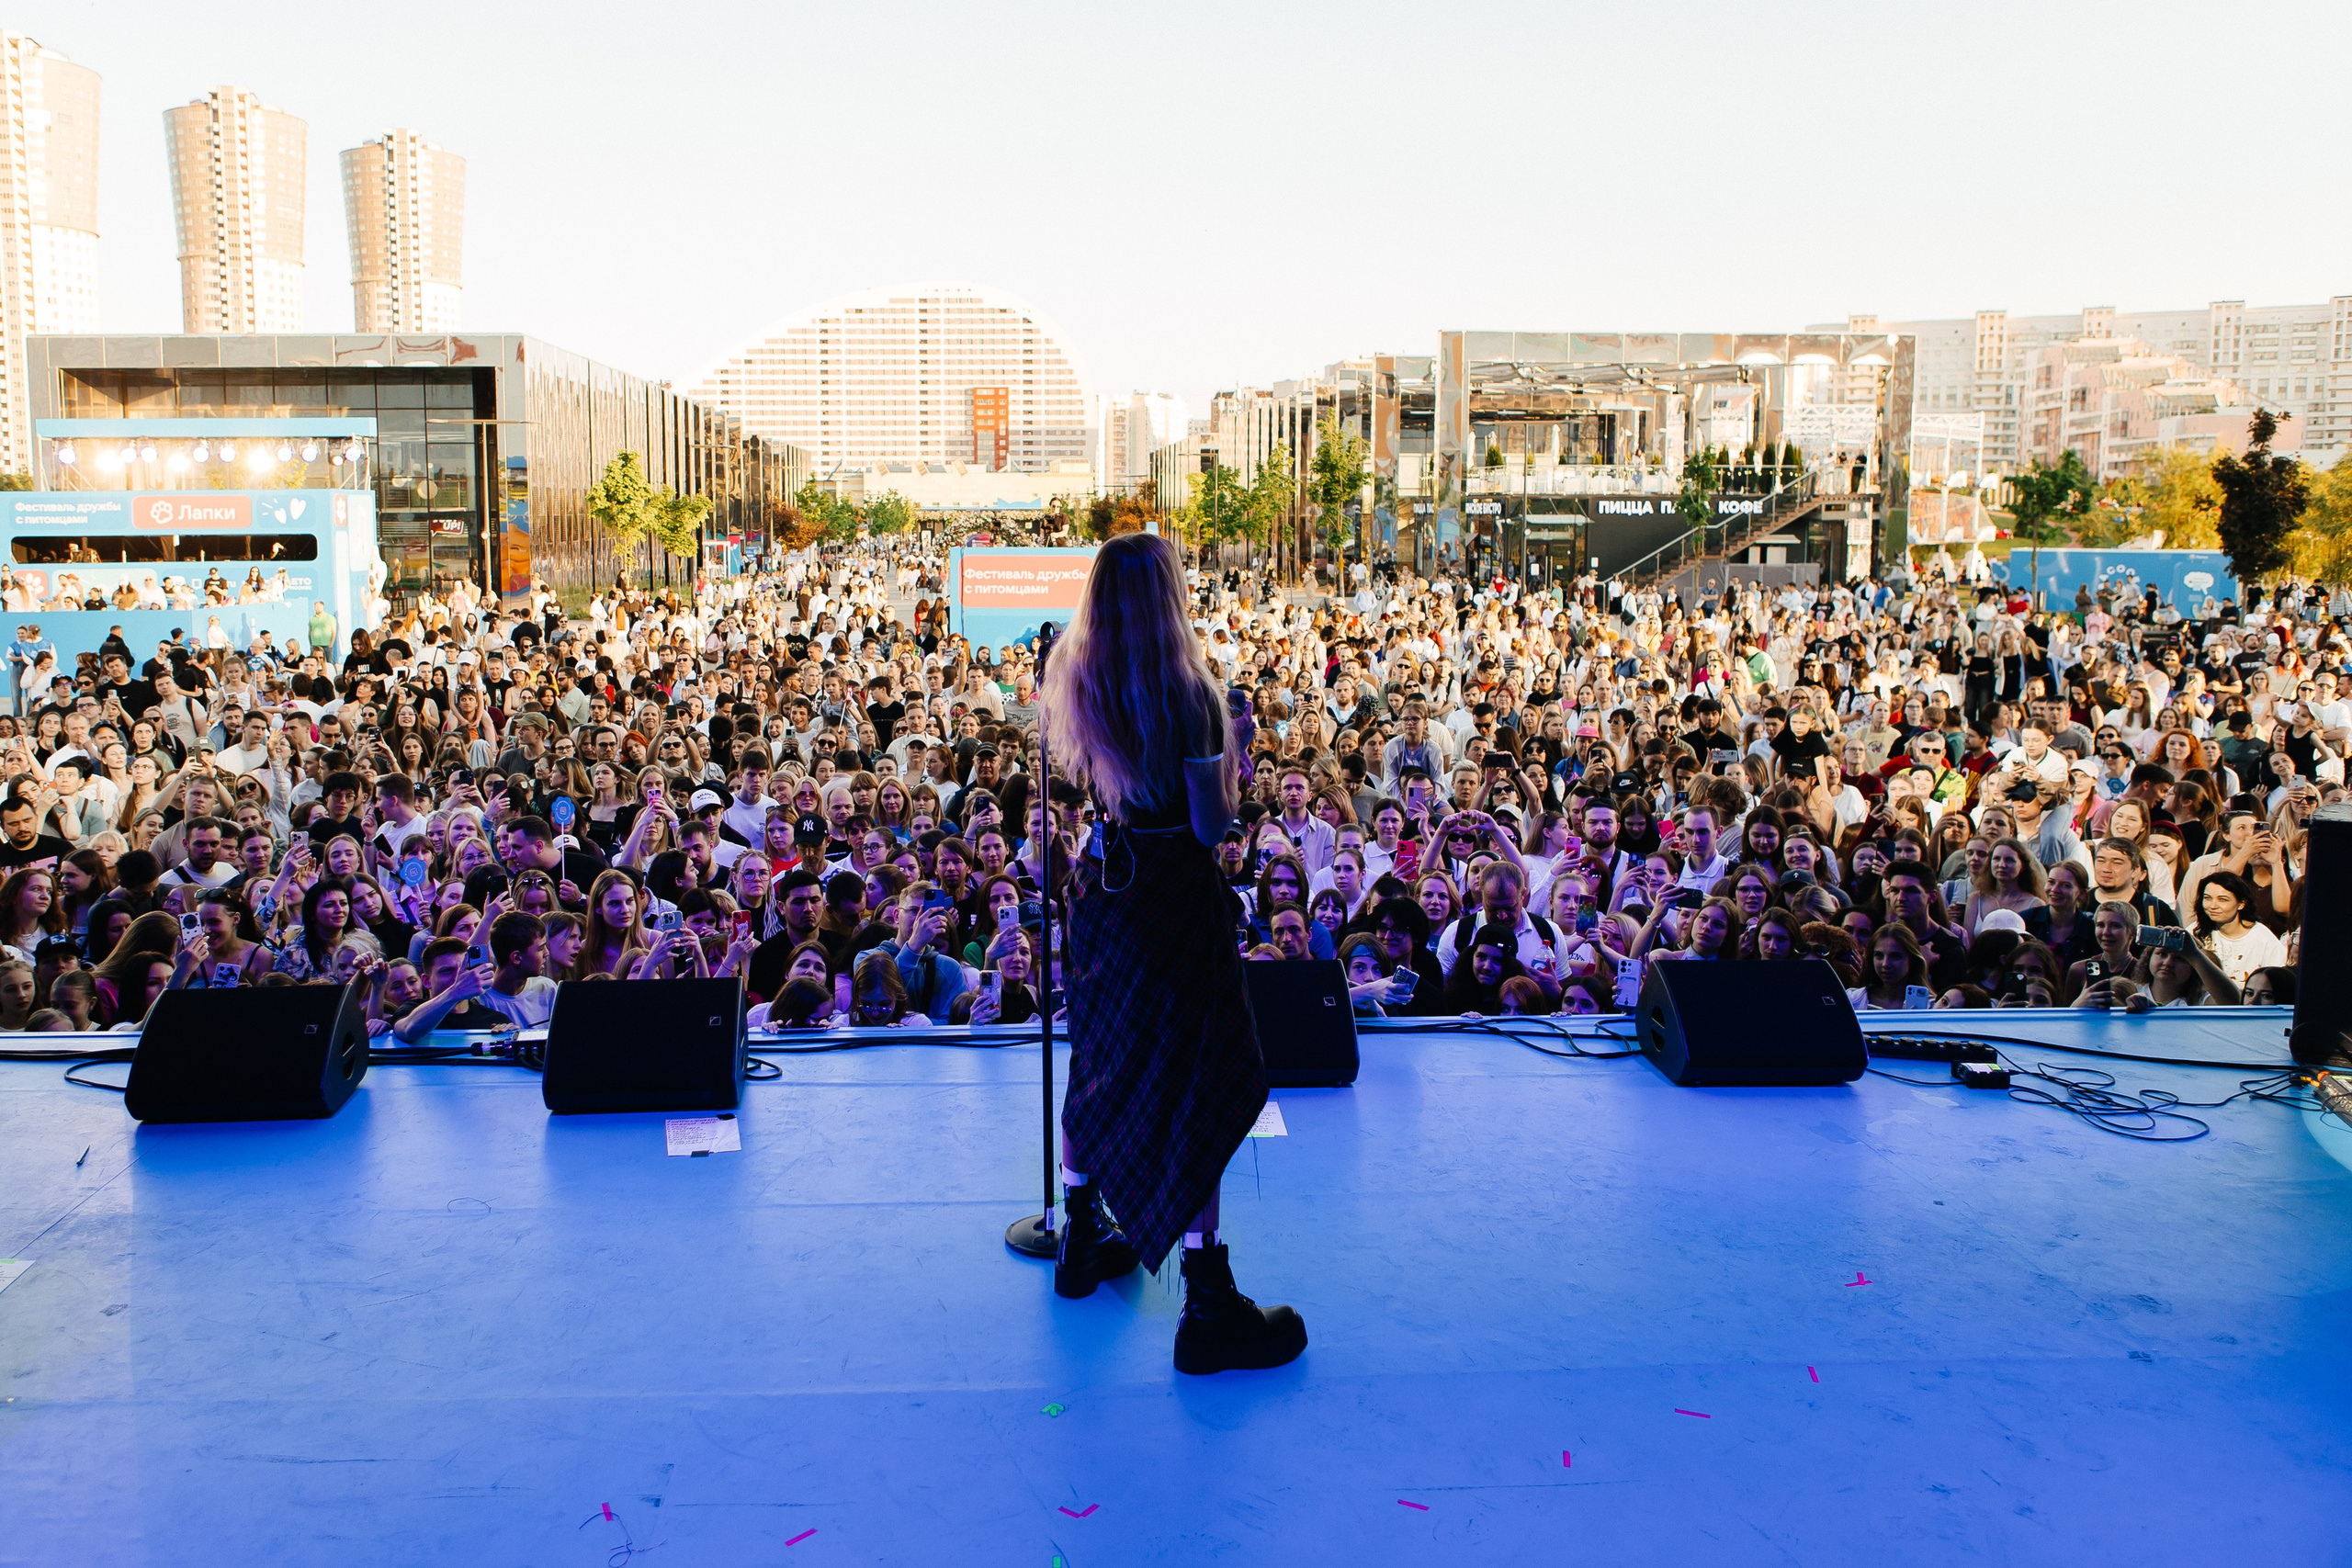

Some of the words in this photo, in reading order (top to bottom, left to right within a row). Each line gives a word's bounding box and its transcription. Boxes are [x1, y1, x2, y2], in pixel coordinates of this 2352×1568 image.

[15, 502, 75, 512] Фестиваль
[76, 502, 121, 513] дружбы
[178, 504, 236, 520] Лапки
[1598, 501, 1654, 516] ПИЦЦА
[1718, 501, 1763, 513] КОФЕ
[25, 516, 88, 525] питомцами
[965, 568, 1035, 580] Фестиваль
[1036, 568, 1088, 582] дружбы
[965, 585, 973, 593] с
[975, 585, 1049, 596] питомцами
